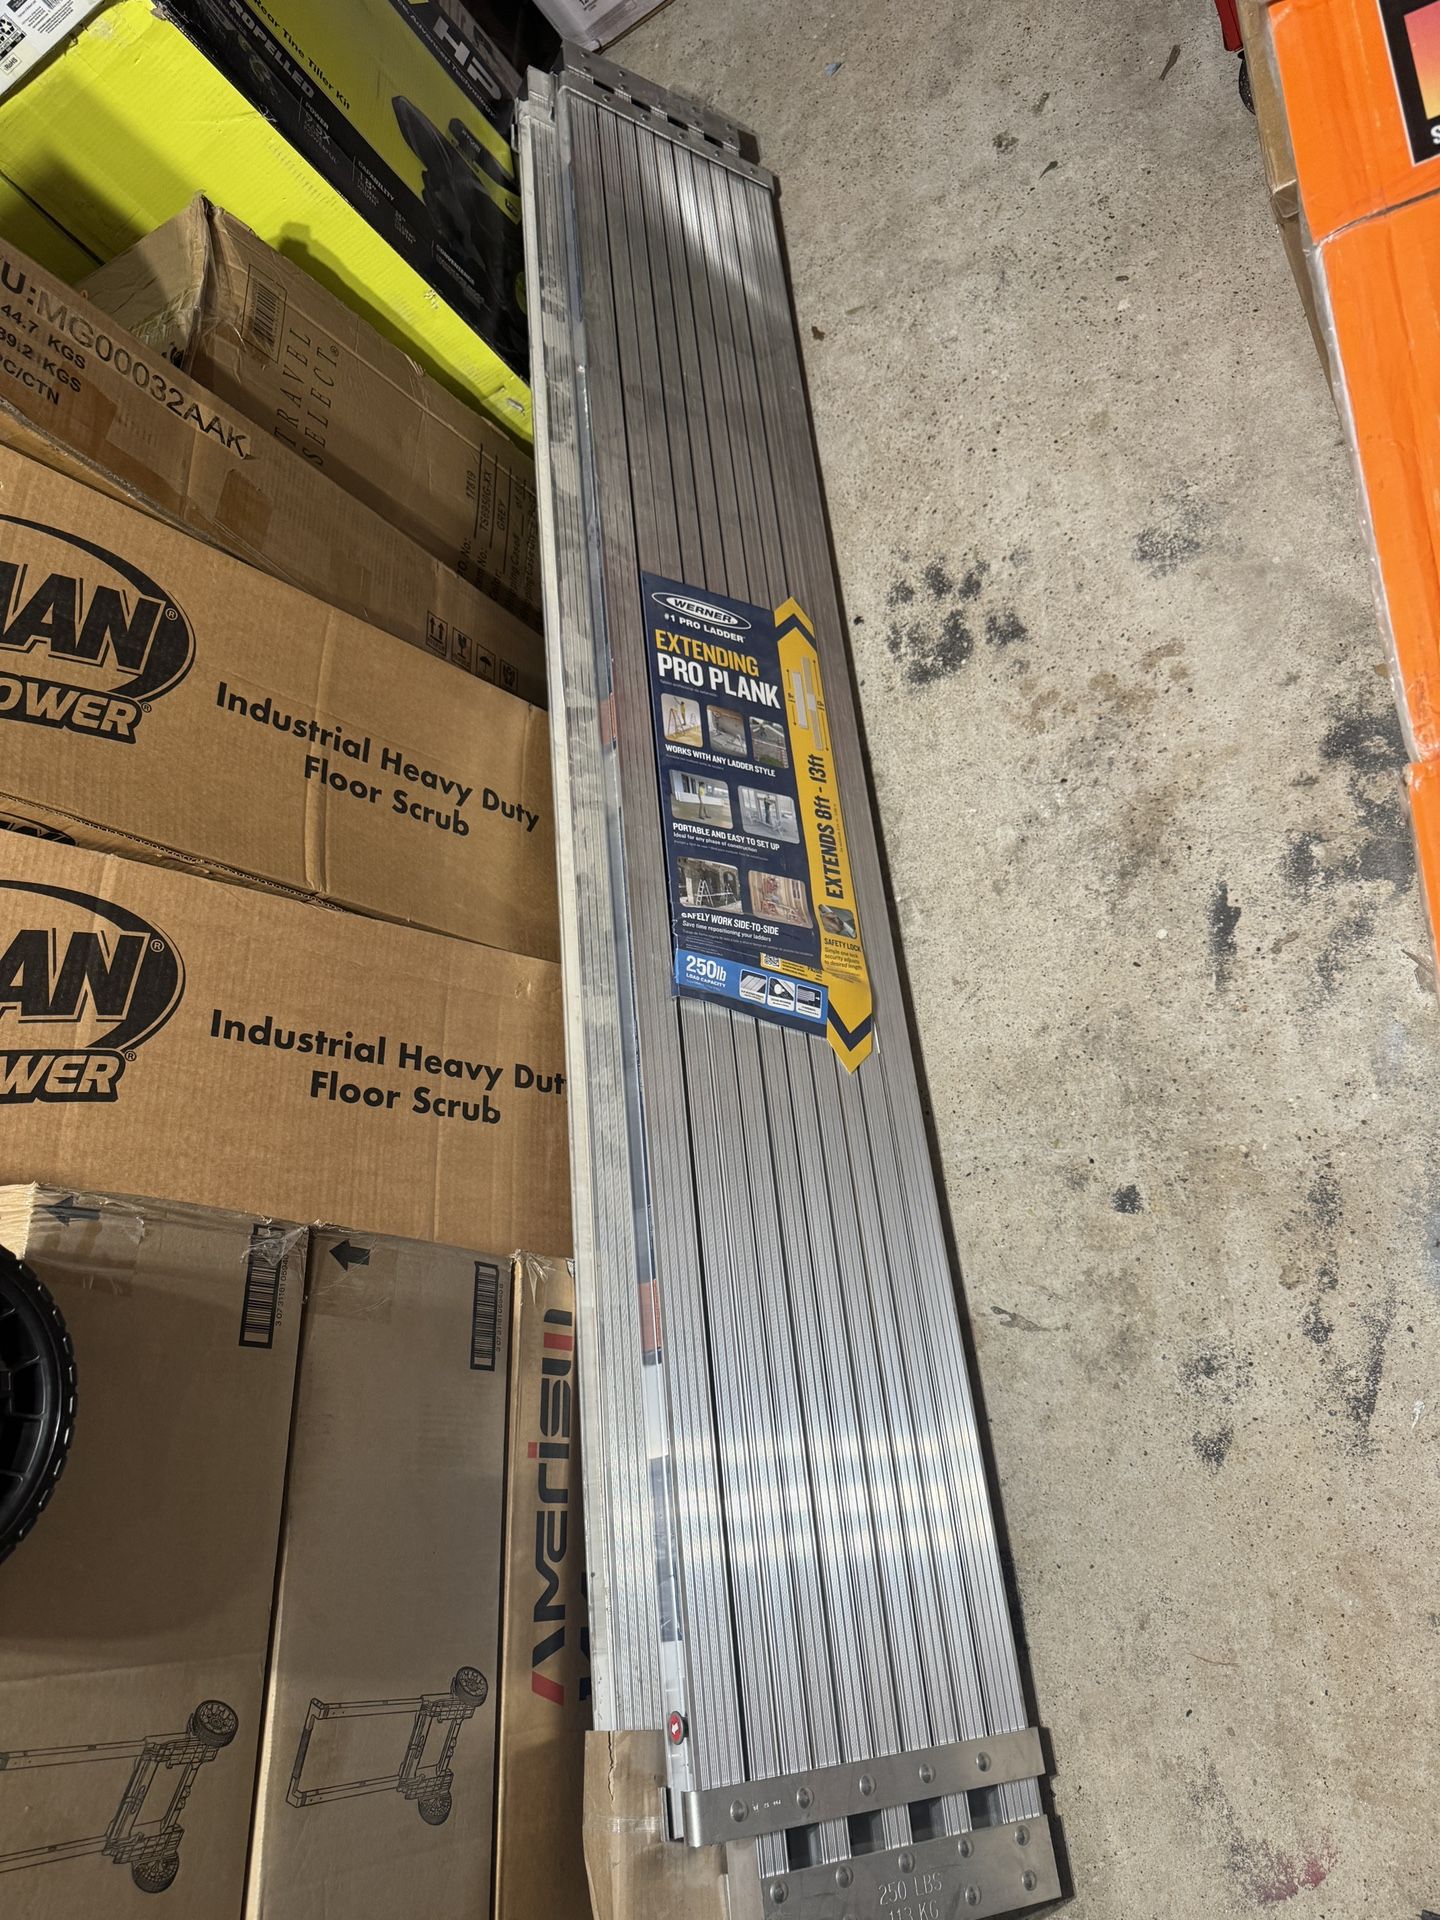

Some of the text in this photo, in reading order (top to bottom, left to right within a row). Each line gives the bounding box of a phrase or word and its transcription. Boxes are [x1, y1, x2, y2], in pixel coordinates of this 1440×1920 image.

[282, 27, 305, 58] Tine
[307, 56, 334, 90] Tiller
[336, 90, 351, 110] Kit
[433, 16, 502, 100] HP
[305, 101, 329, 130] POWER
[1, 303, 86, 370] 44.7 KGS
[42, 356, 82, 393] KGS
[273, 327, 311, 448] TRAVEL
[663, 612, 745, 644] #1 PRO LADDER
[673, 599, 732, 624] WERNER
[655, 629, 759, 677] EXTENDING
[657, 652, 704, 687] PRO
[708, 666, 781, 709] PLANK
[216, 682, 540, 832] Industrial Heavy Duty
[665, 743, 692, 757] WORKS
[692, 749, 711, 762] WITH
[712, 754, 727, 765] ANY
[726, 757, 754, 772] LADDER
[754, 764, 776, 778] STYLE
[807, 753, 827, 784] 13ft
[303, 755, 471, 837] Floor Scrub
[811, 794, 833, 820] 8ft
[672, 822, 710, 840] PORTABLE
[711, 830, 727, 842] AND
[727, 832, 746, 845] EASY
[746, 836, 756, 846] TO
[756, 838, 770, 850] SET
[770, 841, 780, 851] UP
[816, 822, 844, 900] EXTENDS
[682, 920, 772, 943] Save time repositioning your ladders
[711, 914, 733, 928] WORK
[733, 918, 780, 936] SIDE-TO-SIDE
[823, 937, 862, 951] SAFETY LOCK
[686, 954, 727, 982] 250lb
[686, 972, 701, 981] LOAD
[701, 975, 727, 988] CAPACITY
[210, 1009, 567, 1096] Industrial Heavy Dut
[310, 1070, 502, 1126] Floor Scrub
[878, 1872, 942, 1905] 250 LBS
